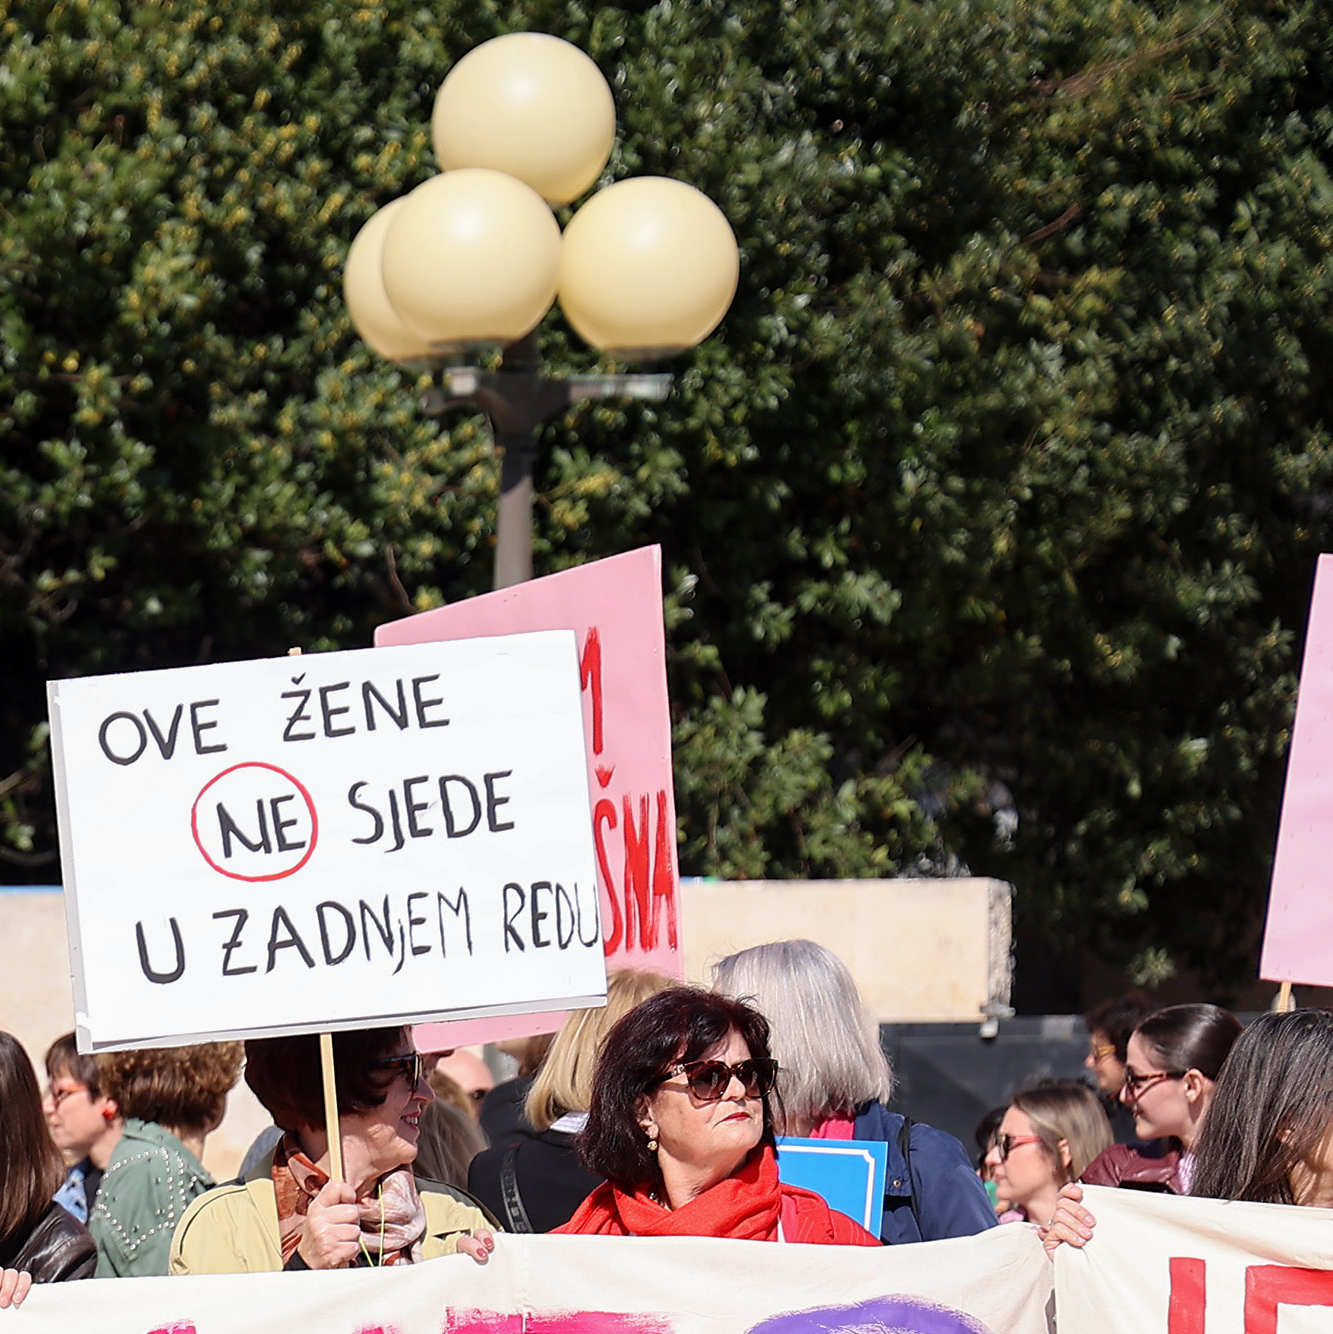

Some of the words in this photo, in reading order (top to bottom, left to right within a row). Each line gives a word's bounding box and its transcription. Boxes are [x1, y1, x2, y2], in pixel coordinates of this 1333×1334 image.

[98, 699, 228, 766] OVE
[280, 673, 451, 742] ŽENE
[215, 794, 307, 859] NE
[347, 769, 515, 854] SJEDE
[135, 917, 187, 985] U
[211, 886, 473, 976] ZADNJEM
[501, 881, 599, 954] REDU
